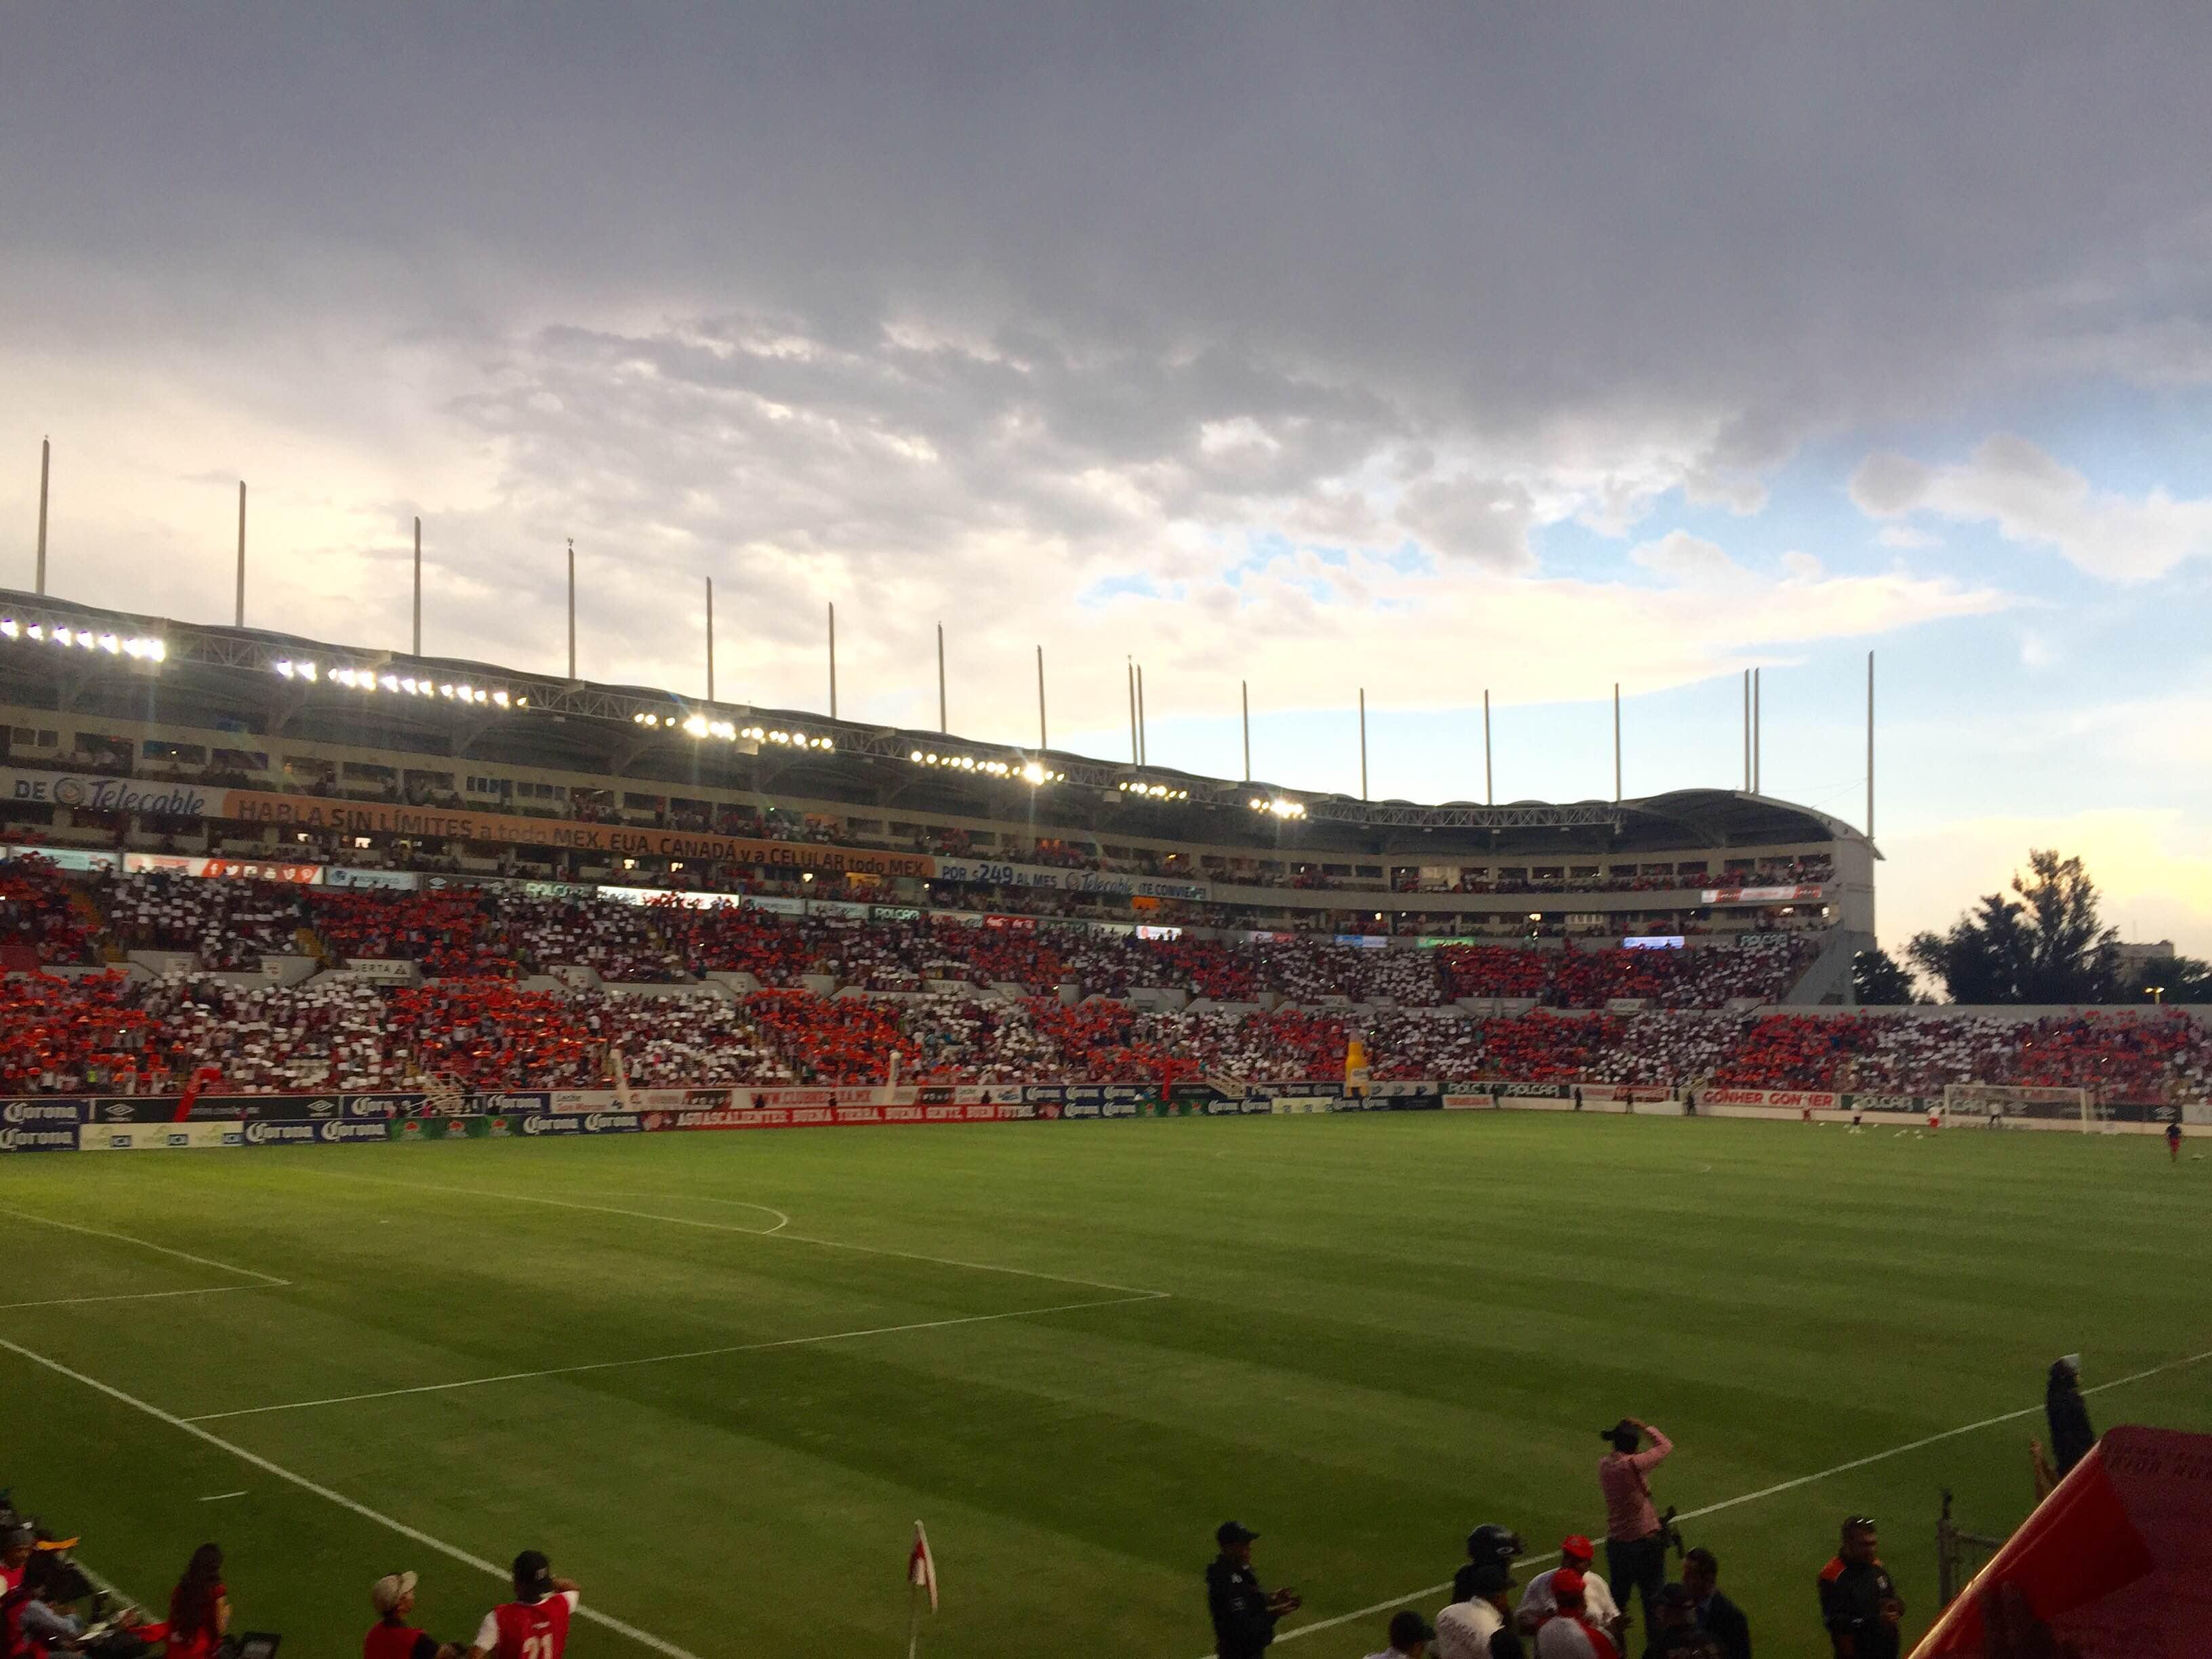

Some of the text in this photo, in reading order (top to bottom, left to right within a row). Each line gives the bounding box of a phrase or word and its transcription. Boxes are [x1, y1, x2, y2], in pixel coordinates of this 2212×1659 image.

[15, 779, 205, 815] DE Telecable
[239, 800, 323, 826] HABLA
[331, 808, 372, 831] SIN
[659, 838, 736, 861] CANADÁ
[754, 851, 765, 863] a
[770, 848, 844, 872] CELULAR
[942, 865, 966, 881] POR
[1767, 1092, 1832, 1107] GONER
